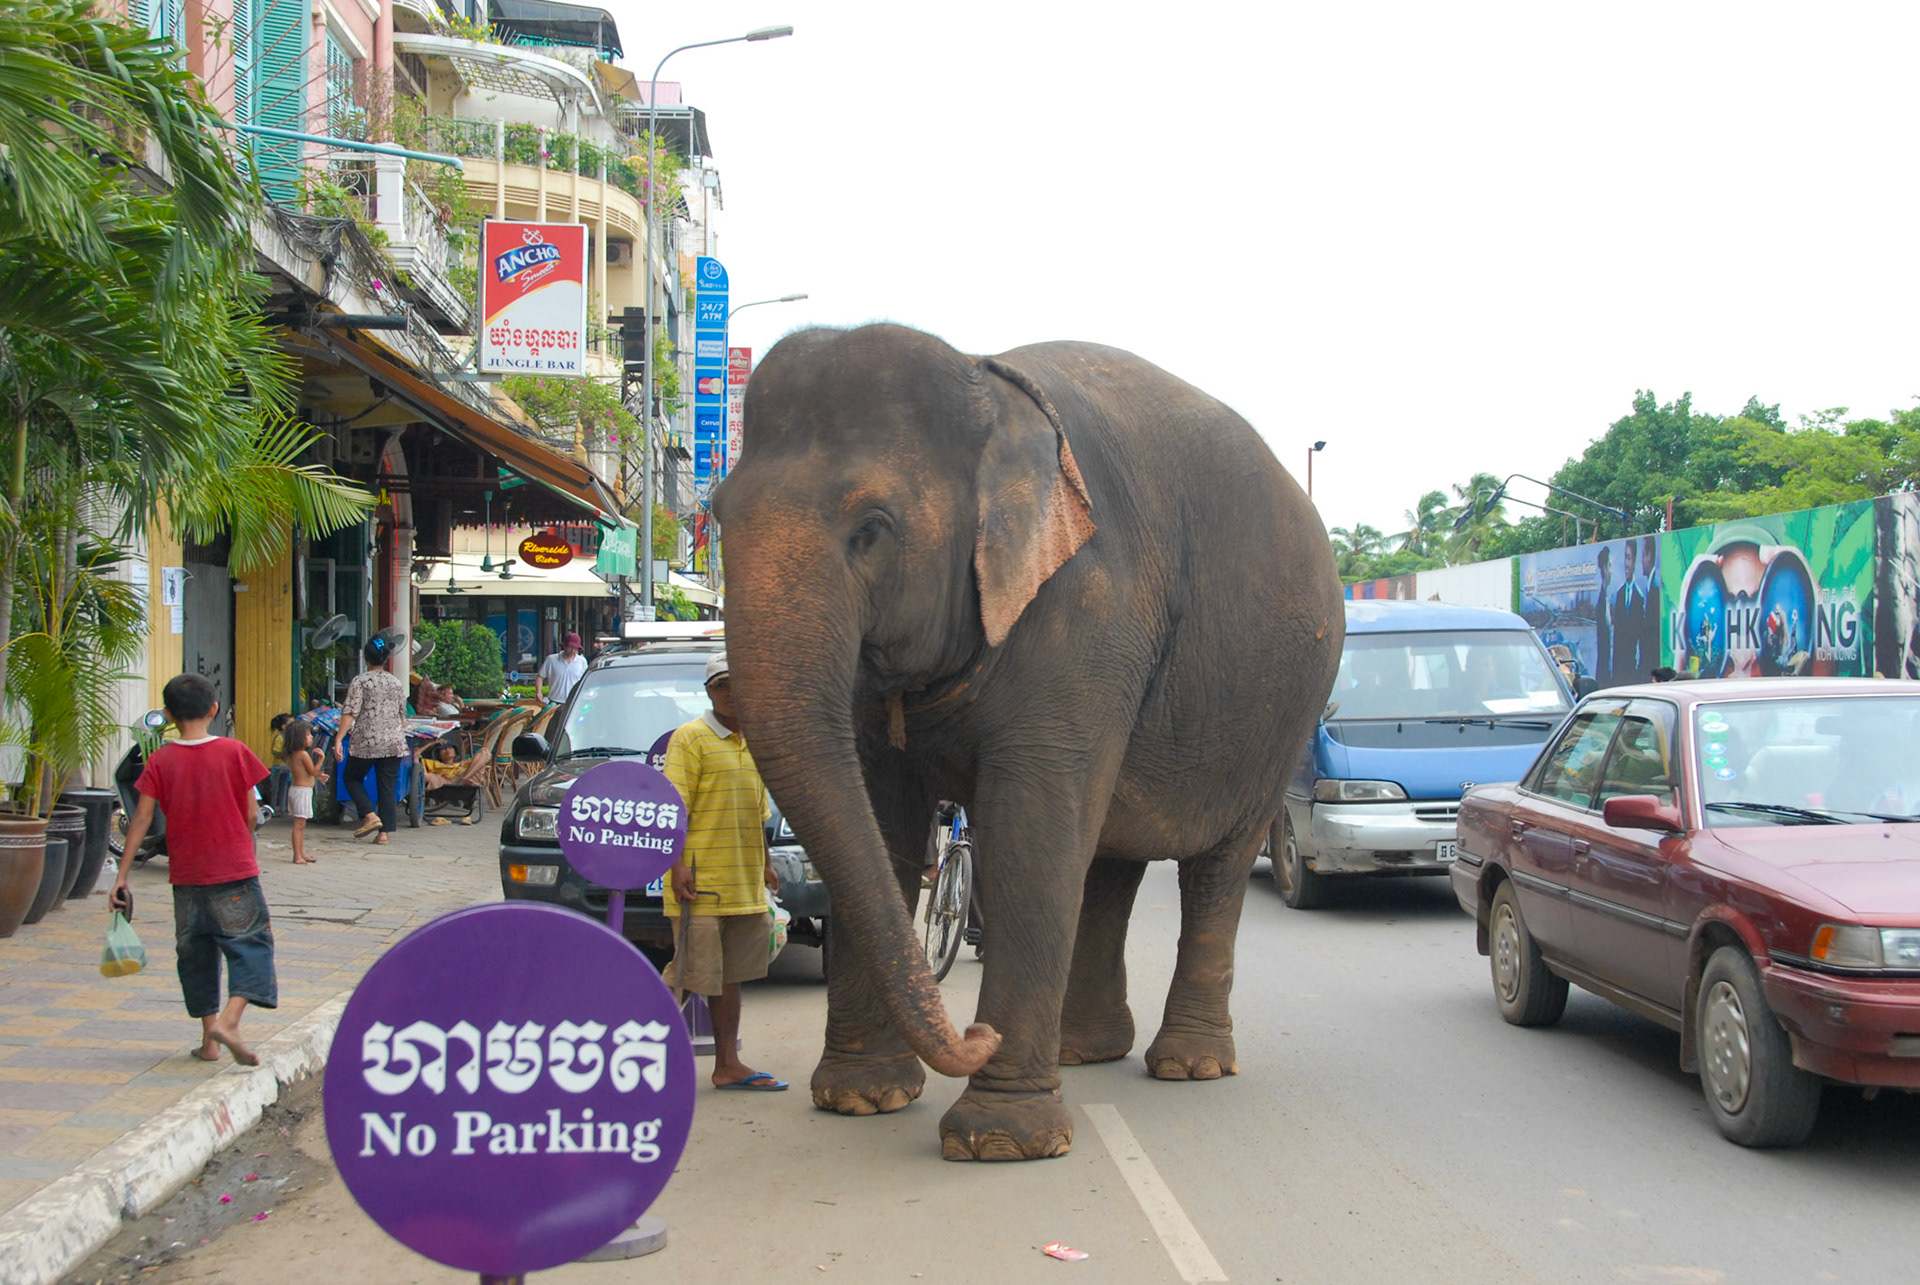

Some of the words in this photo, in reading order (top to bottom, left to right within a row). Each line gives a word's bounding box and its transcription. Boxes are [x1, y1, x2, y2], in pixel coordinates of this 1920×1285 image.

[701, 303, 724, 312] 24/7
[702, 312, 722, 320] ATM
[488, 358, 543, 369] JUNGLE
[548, 360, 575, 370] BAR
[523, 541, 569, 554] Riverside
[1816, 650, 1832, 661] KOH
[1833, 648, 1857, 661] KONG
[568, 826, 595, 844] No
[600, 828, 674, 855] Parking
[359, 1111, 437, 1157] No
[451, 1107, 663, 1163] Parking
